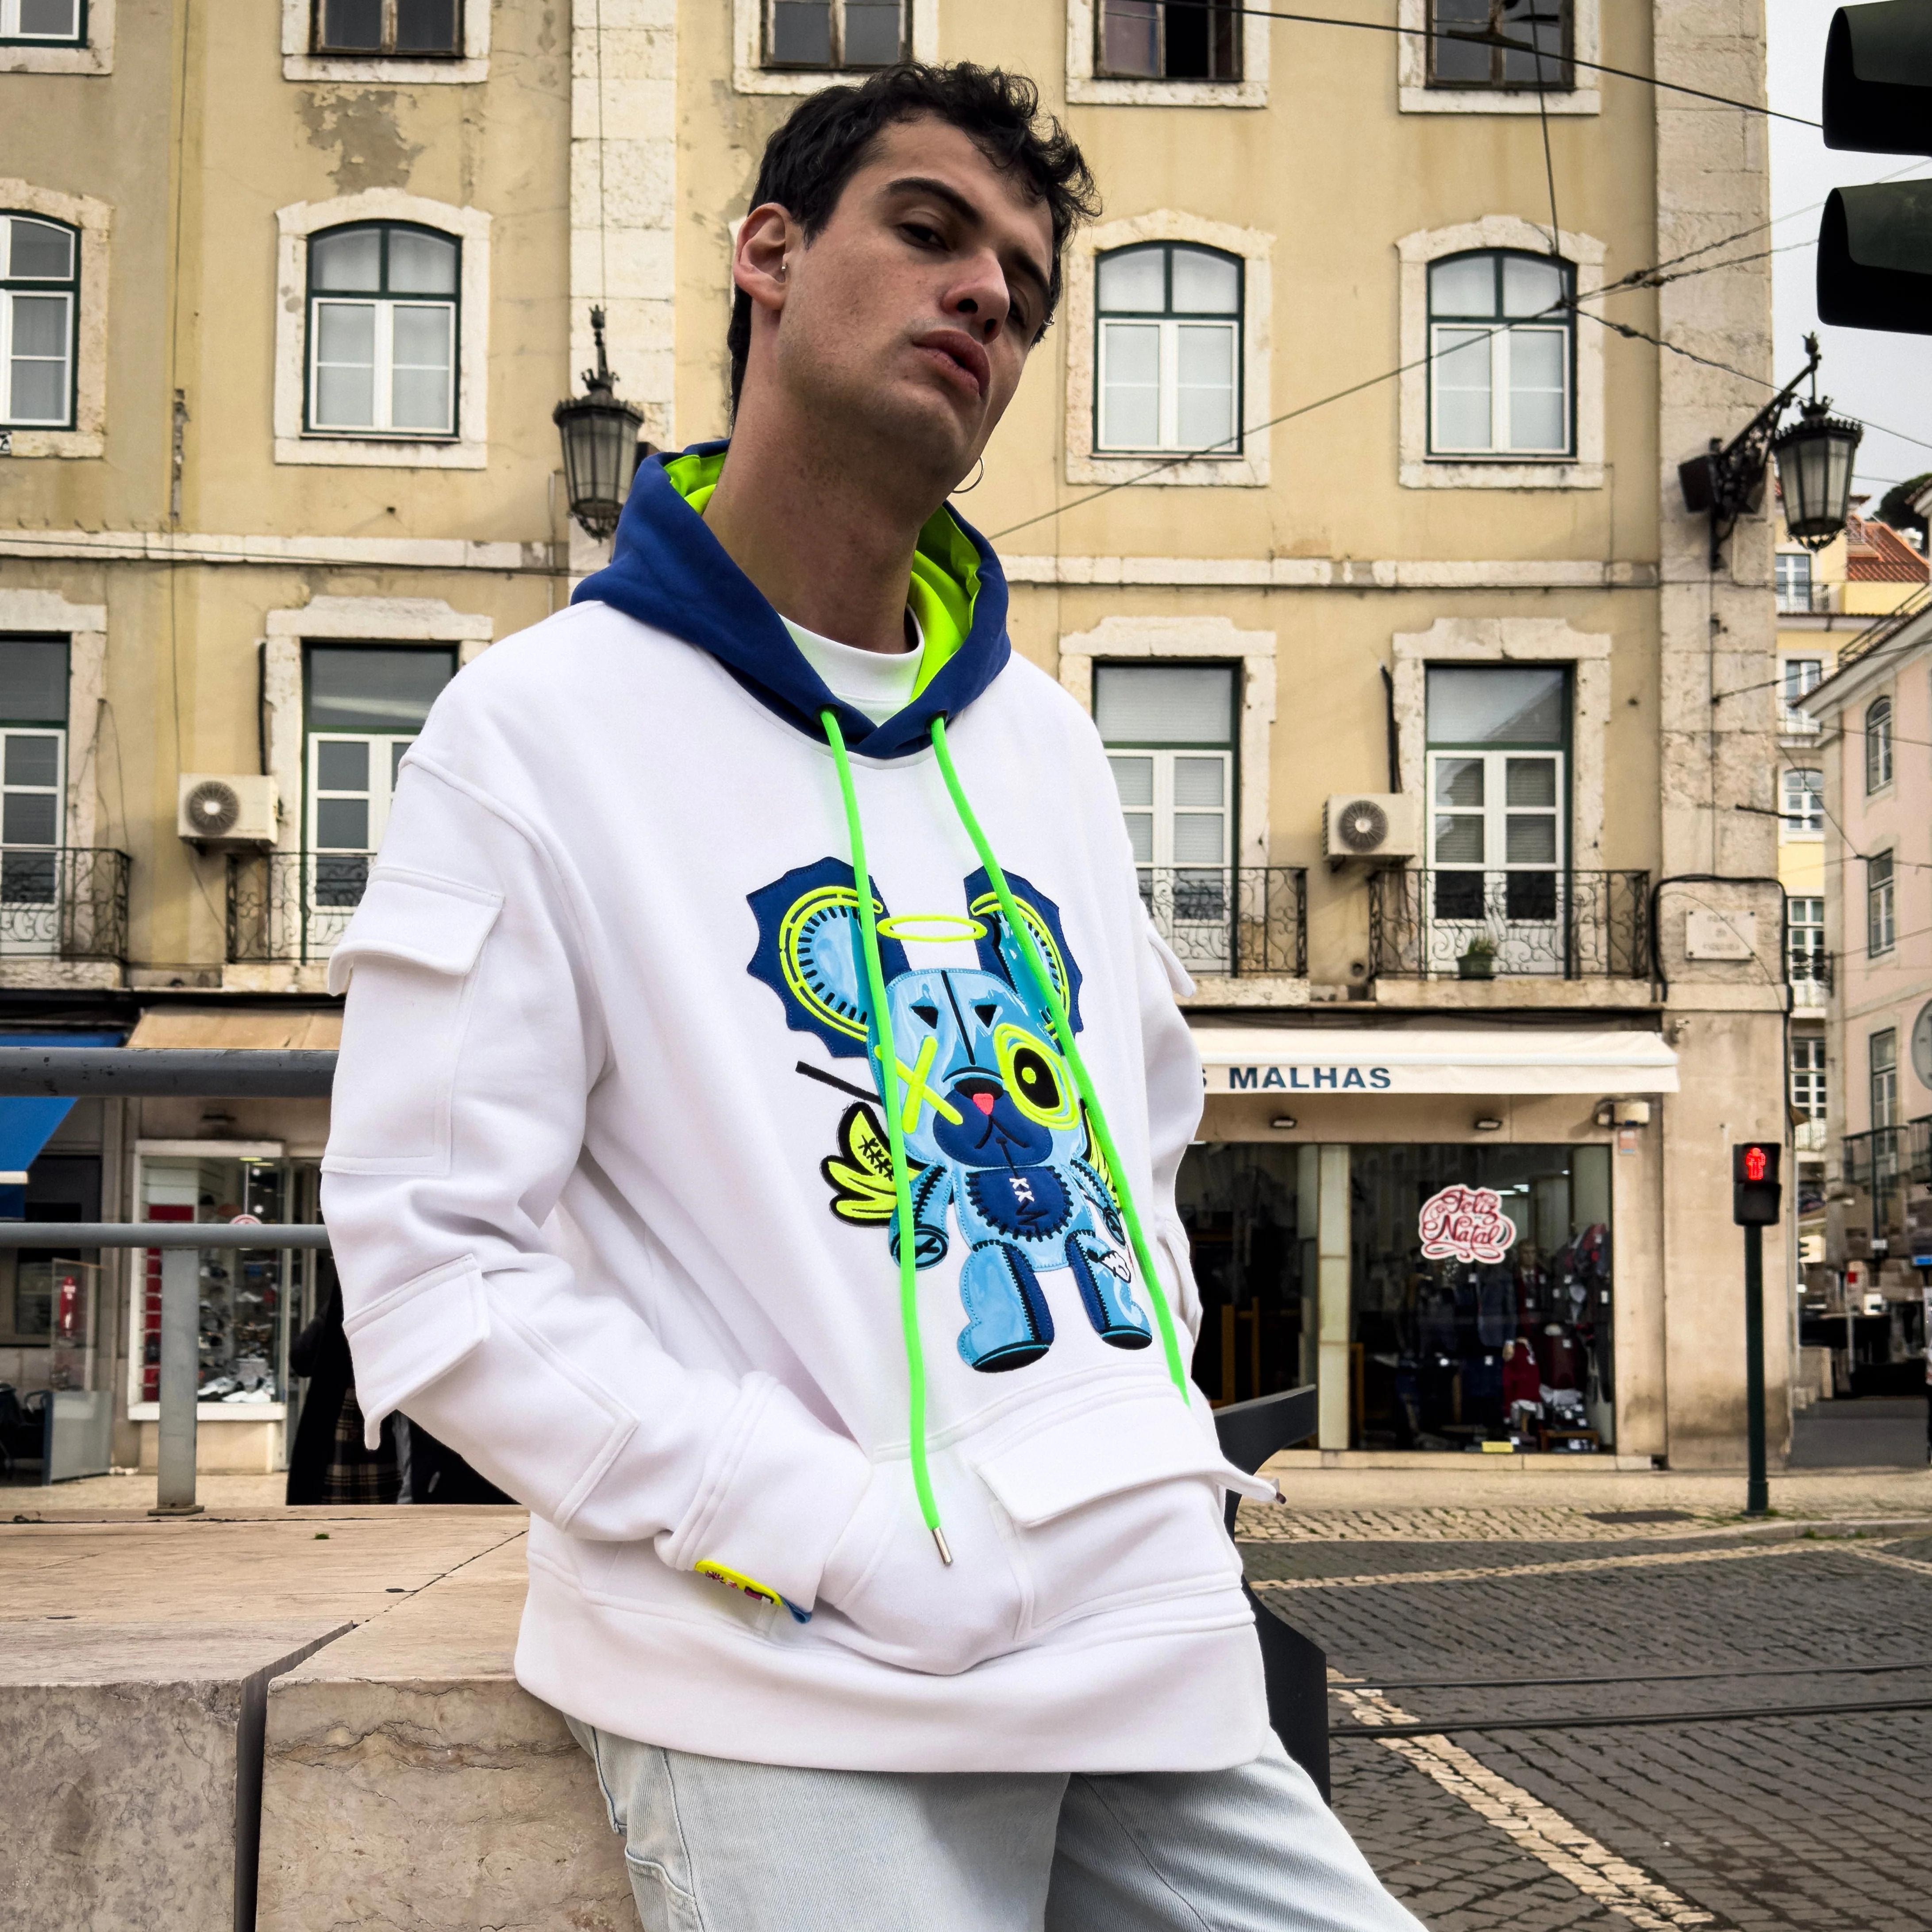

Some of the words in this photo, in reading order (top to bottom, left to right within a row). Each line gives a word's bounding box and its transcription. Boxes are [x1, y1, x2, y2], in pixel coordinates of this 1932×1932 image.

[1229, 1067, 1391, 1089] MALHAS
[1438, 1189, 1498, 1224] Feliz
[1423, 1215, 1503, 1250] Natal
